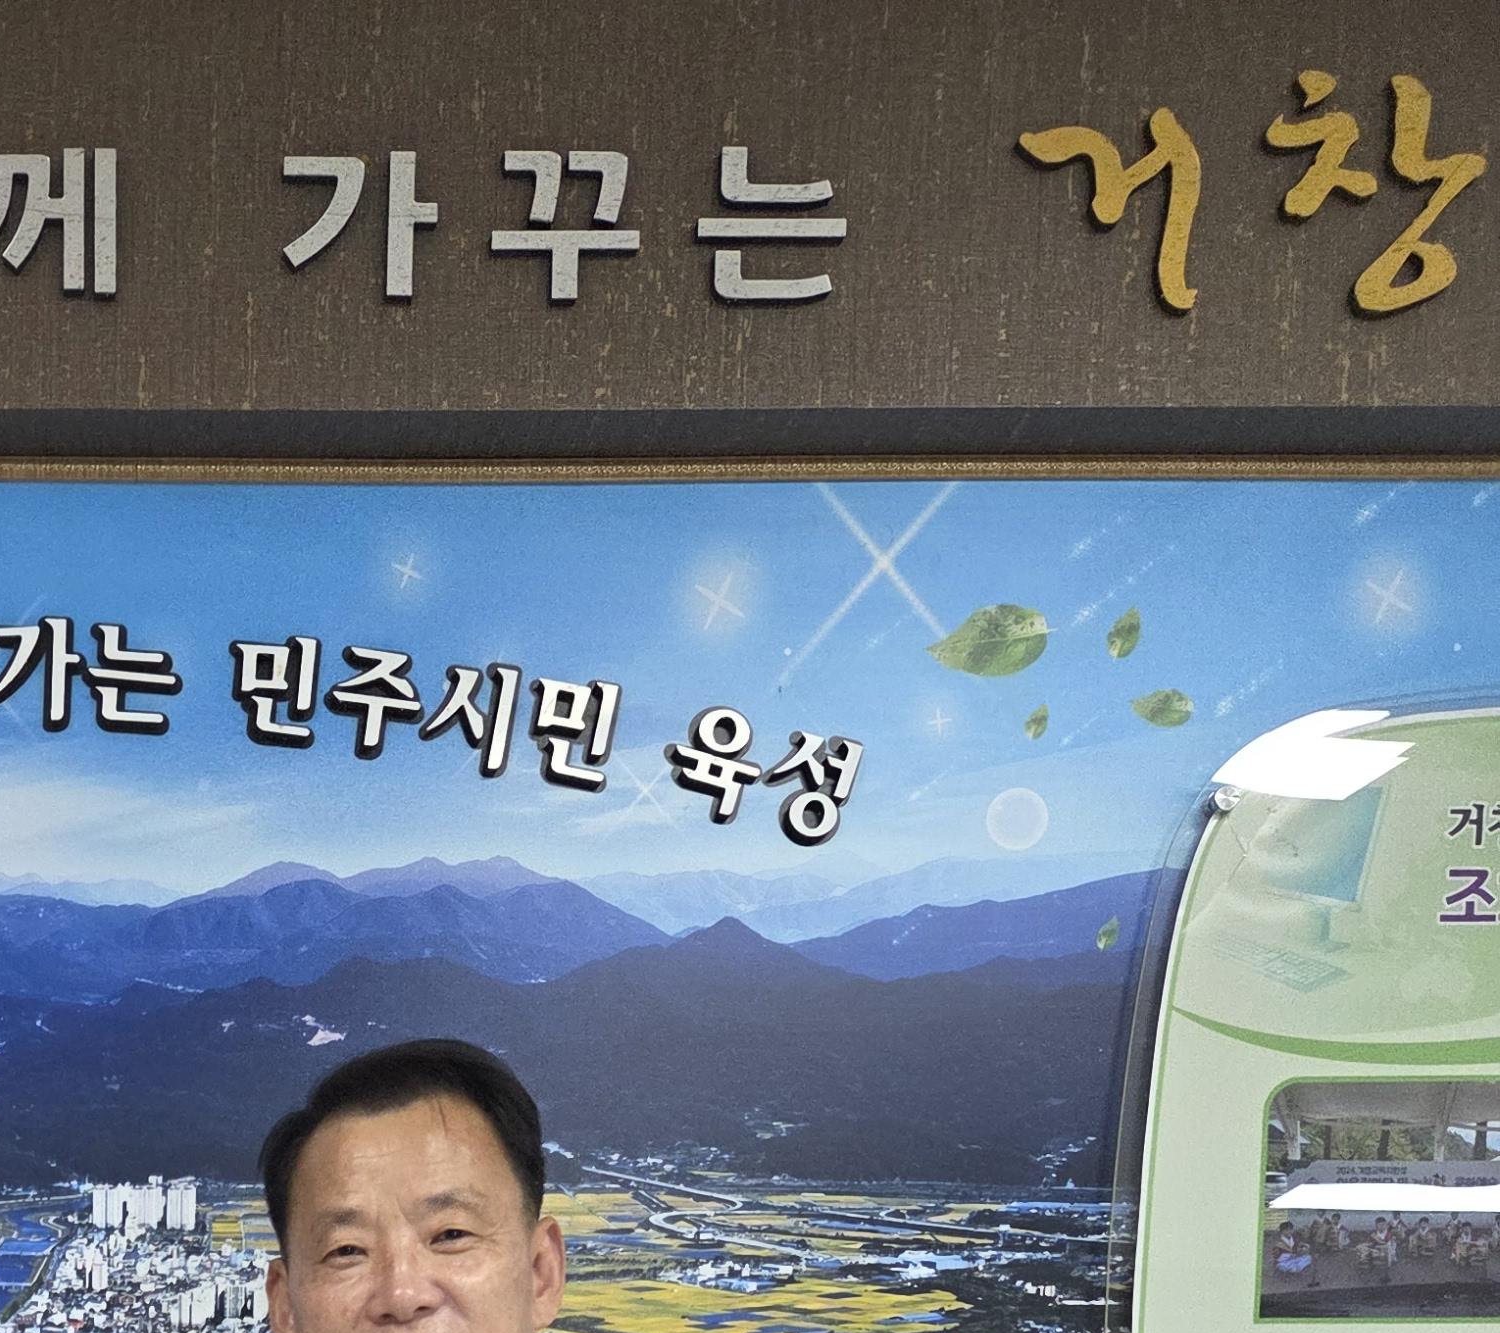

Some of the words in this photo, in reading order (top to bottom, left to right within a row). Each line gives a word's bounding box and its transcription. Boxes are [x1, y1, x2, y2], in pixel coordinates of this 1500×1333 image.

[282, 146, 848, 302] 가꾸는
[1018, 68, 1490, 314] 거창
[230, 635, 623, 793] 민주시민
[664, 705, 867, 847] 육성
